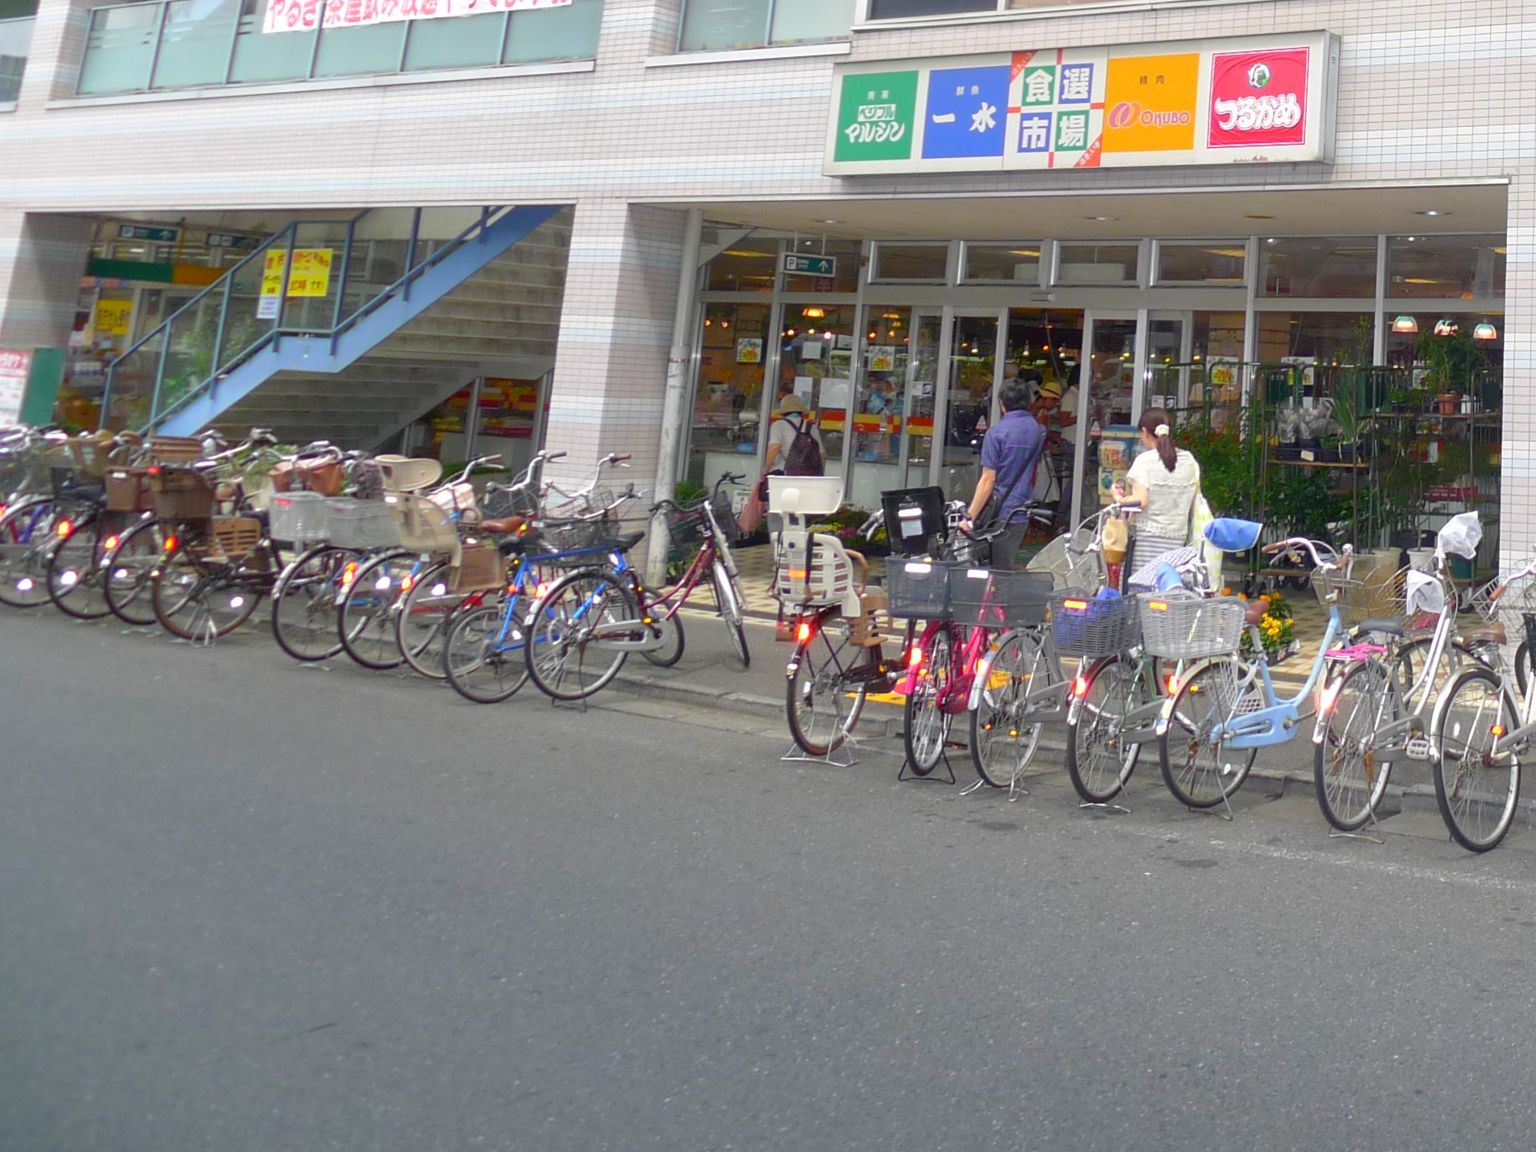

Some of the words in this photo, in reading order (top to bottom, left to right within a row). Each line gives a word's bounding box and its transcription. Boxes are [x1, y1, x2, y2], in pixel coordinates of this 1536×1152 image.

[1215, 93, 1301, 132] つるかめ
[844, 122, 905, 144] マルシン
